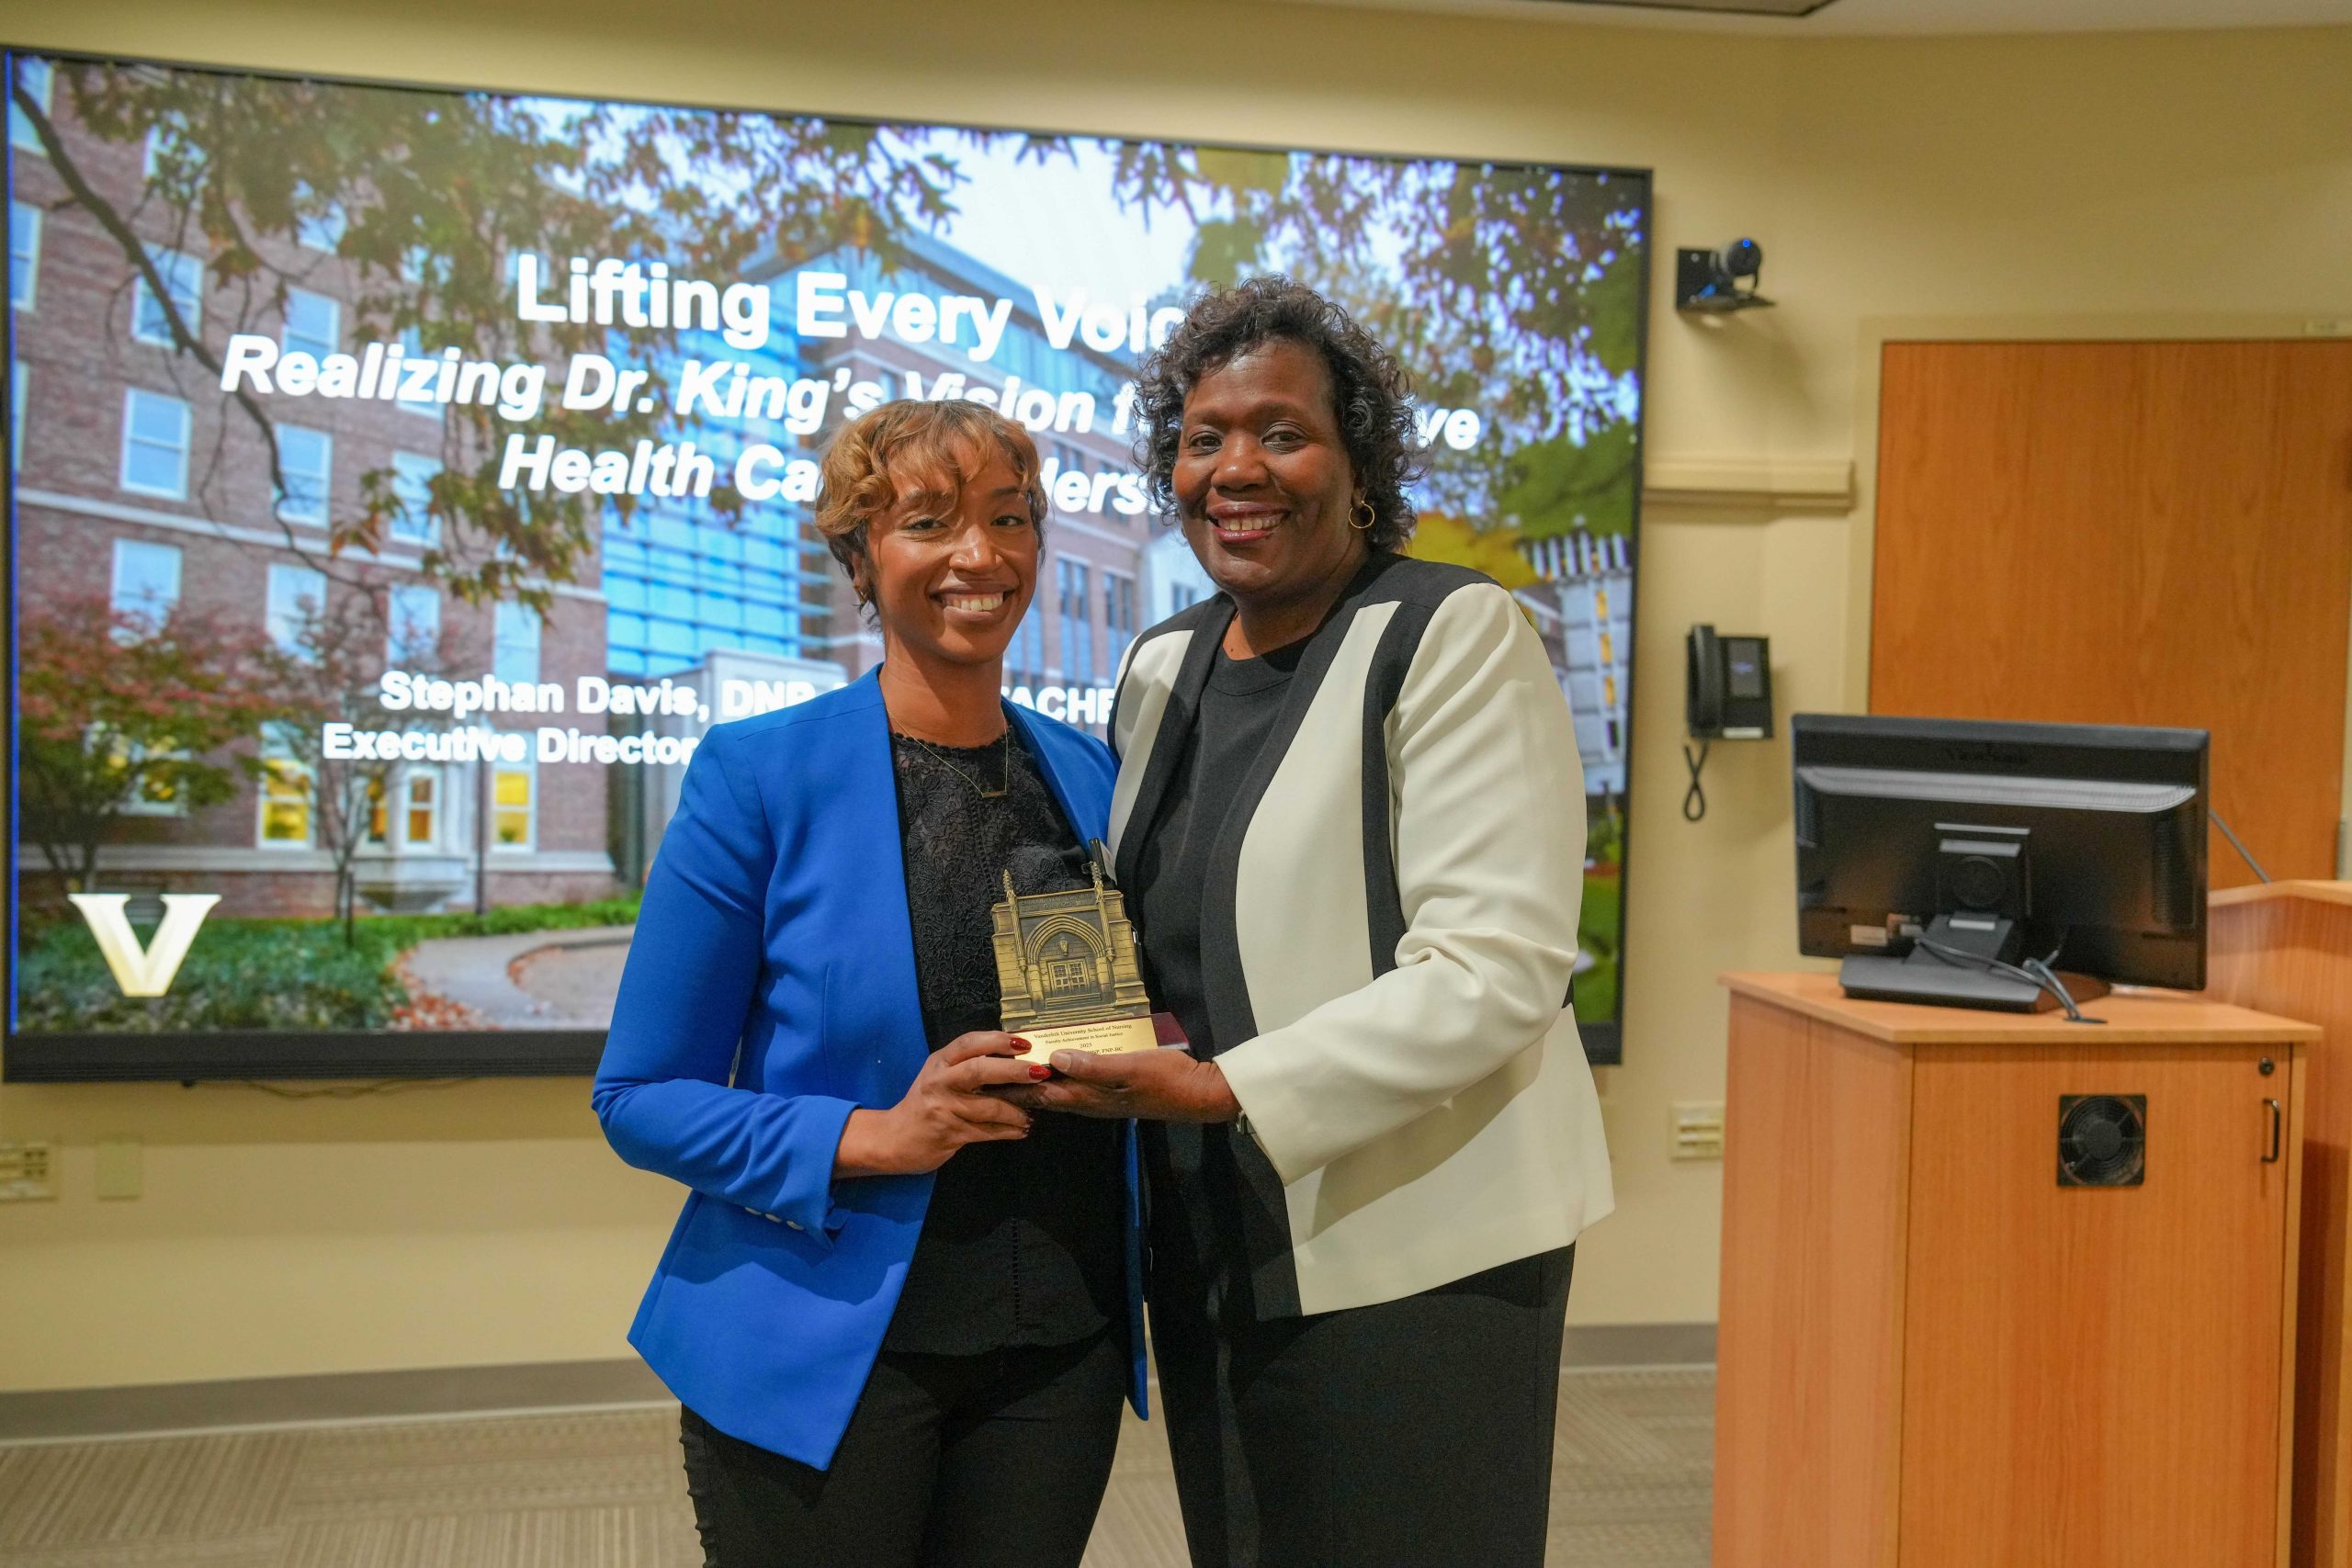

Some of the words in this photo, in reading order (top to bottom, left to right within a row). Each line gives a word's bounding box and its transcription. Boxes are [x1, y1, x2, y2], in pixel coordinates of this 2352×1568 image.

[518, 254, 770, 350] Lifting
[797, 270, 1013, 362] Every
[1033, 284, 1186, 354] Voic
[220, 334, 547, 422] Realizing
[562, 353, 653, 413] Dr.
[675, 359, 884, 434] King's
[497, 433, 715, 498] Health
[735, 444, 820, 502] Ca
[379, 670, 564, 719] Stephan
[577, 676, 710, 723] Davis,
[1001, 685, 1115, 724] ACHE
[323, 722, 526, 762] Executive
[68, 893, 221, 998] V
[1034, 1031, 1060, 1039] Vanderbilt
[1060, 1028, 1087, 1037] University
[1061, 1035, 1090, 1043] Achievement
